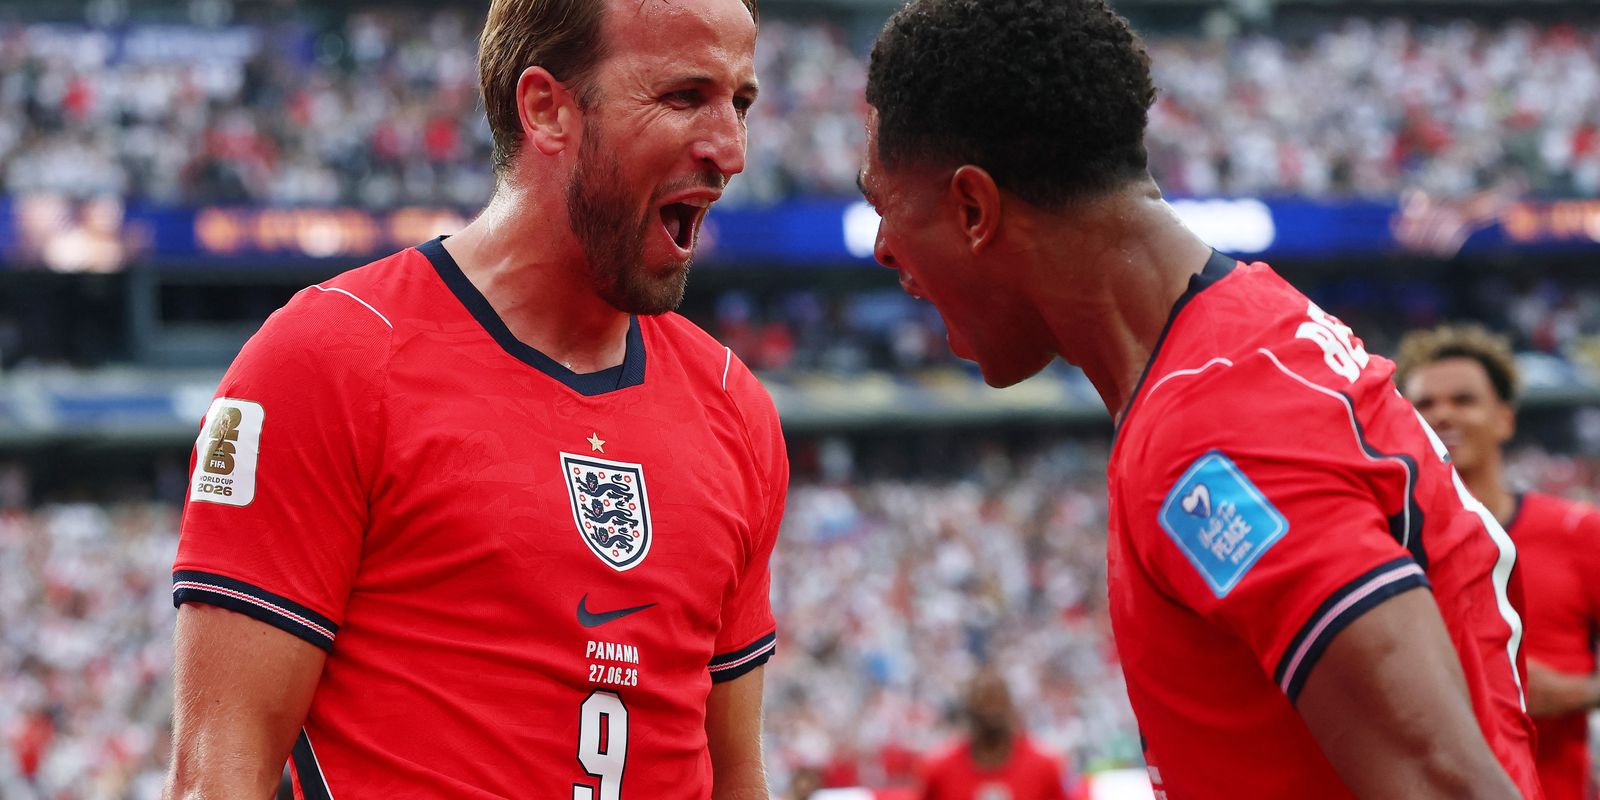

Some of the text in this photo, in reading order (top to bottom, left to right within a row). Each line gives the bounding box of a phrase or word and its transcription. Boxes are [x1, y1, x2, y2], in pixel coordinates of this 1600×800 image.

[209, 459, 226, 470] FIFA
[198, 482, 233, 497] 2026
[221, 477, 234, 486] CUP
[1211, 514, 1252, 562] PEACE
[586, 640, 639, 665] PANAMA
[588, 663, 638, 687] 27.06.26
[572, 688, 629, 800] 9
